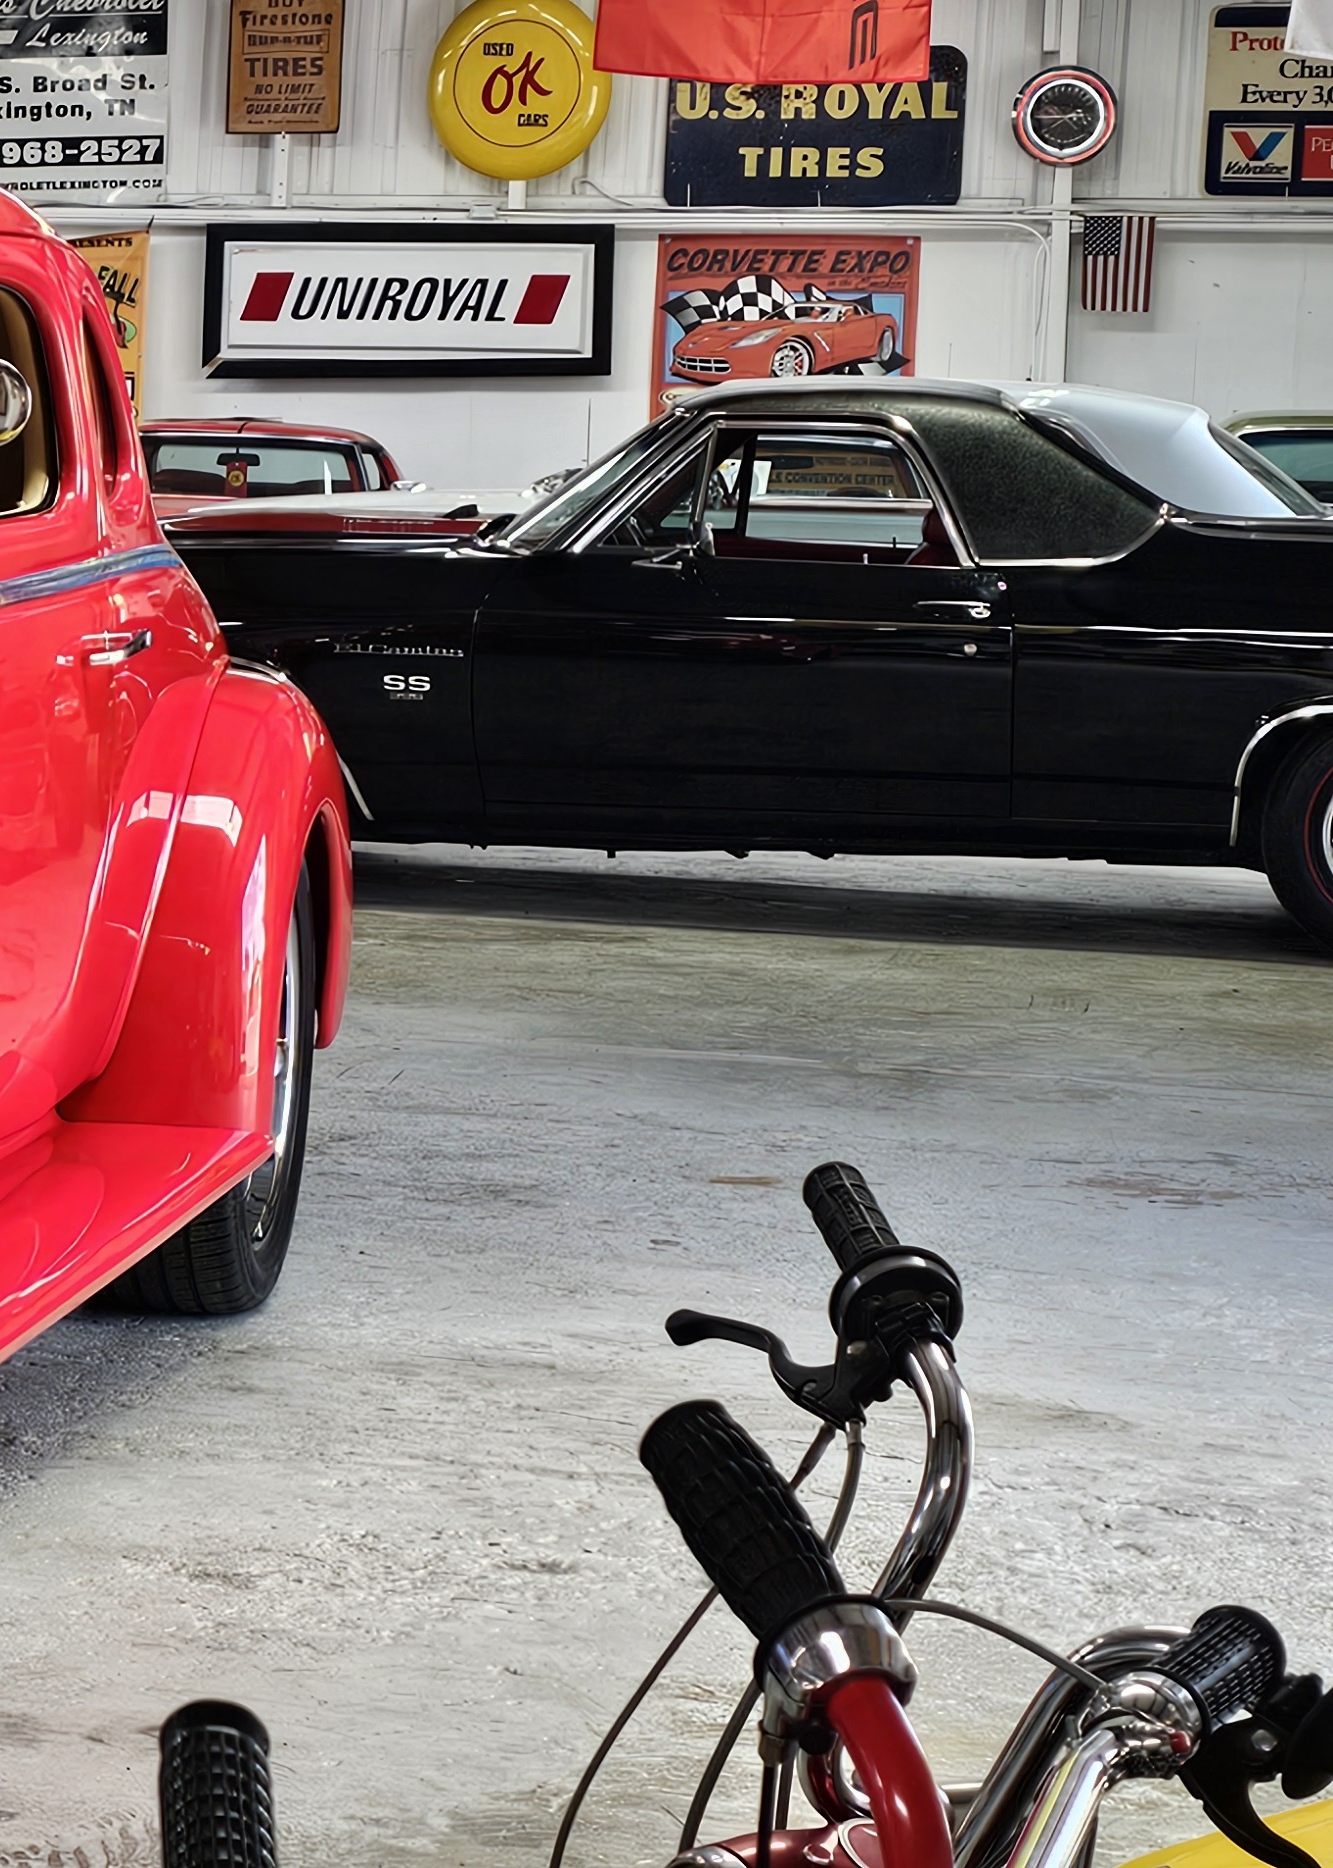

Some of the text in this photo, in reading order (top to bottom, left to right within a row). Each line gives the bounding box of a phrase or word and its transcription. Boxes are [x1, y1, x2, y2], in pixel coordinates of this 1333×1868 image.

[239, 10, 333, 29] Firestone
[25, 23, 148, 52] Lexington
[483, 43, 514, 56] USED
[244, 57, 324, 77] TIRES
[33, 74, 108, 93] Broad
[120, 74, 156, 91] St.
[254, 83, 315, 94] NO LIMIT
[481, 51, 553, 115] OK
[675, 82, 958, 120] U.S. ROYAL
[1240, 84, 1308, 108] Every
[104, 99, 136, 116] TN
[246, 103, 323, 114] GUARANTEE
[517, 114, 549, 127] CARS
[738, 147, 885, 178] TIRES
[666, 248, 912, 274] CORVETTE EXPO
[291, 276, 509, 322] UNIROYAL
[383, 674, 431, 692] SS
